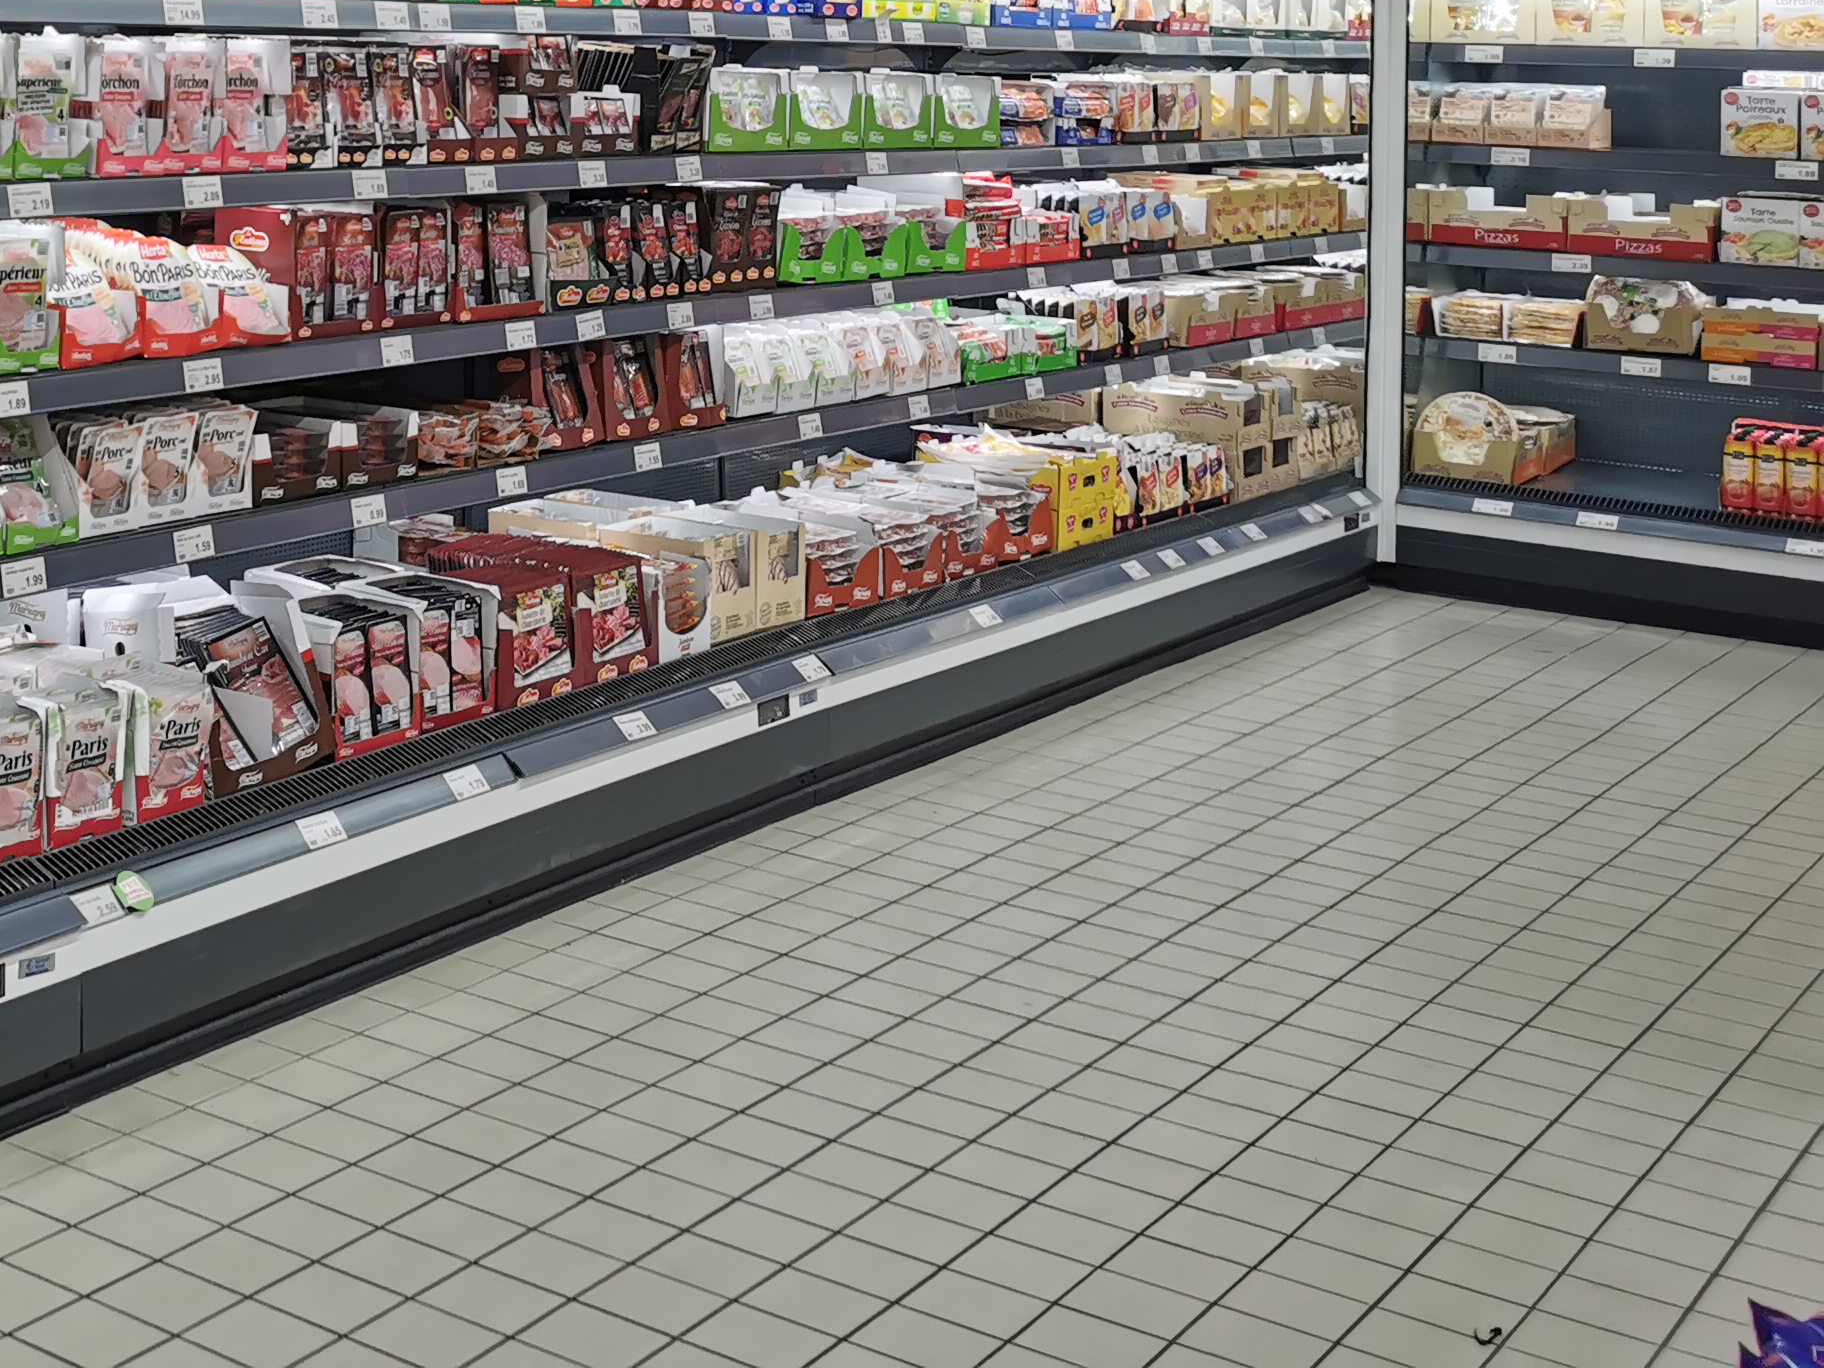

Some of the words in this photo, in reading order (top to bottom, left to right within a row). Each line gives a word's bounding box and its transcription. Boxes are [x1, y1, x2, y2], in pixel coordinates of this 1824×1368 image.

[1746, 96, 1776, 105] Tarte
[1736, 105, 1787, 114] Poireaux
[32, 199, 50, 210] 2.19
[1751, 208, 1776, 217] Tarte
[1474, 228, 1520, 243] Pizzas
[141, 244, 167, 259] Herta
[1614, 238, 1662, 253] Pizzas
[200, 248, 226, 261] Herta
[211, 428, 235, 442] Porc
[153, 435, 178, 450] Porc
[25, 574, 43, 587] 1.99
[166, 717, 201, 739] Paris
[71, 735, 108, 760] Paris
